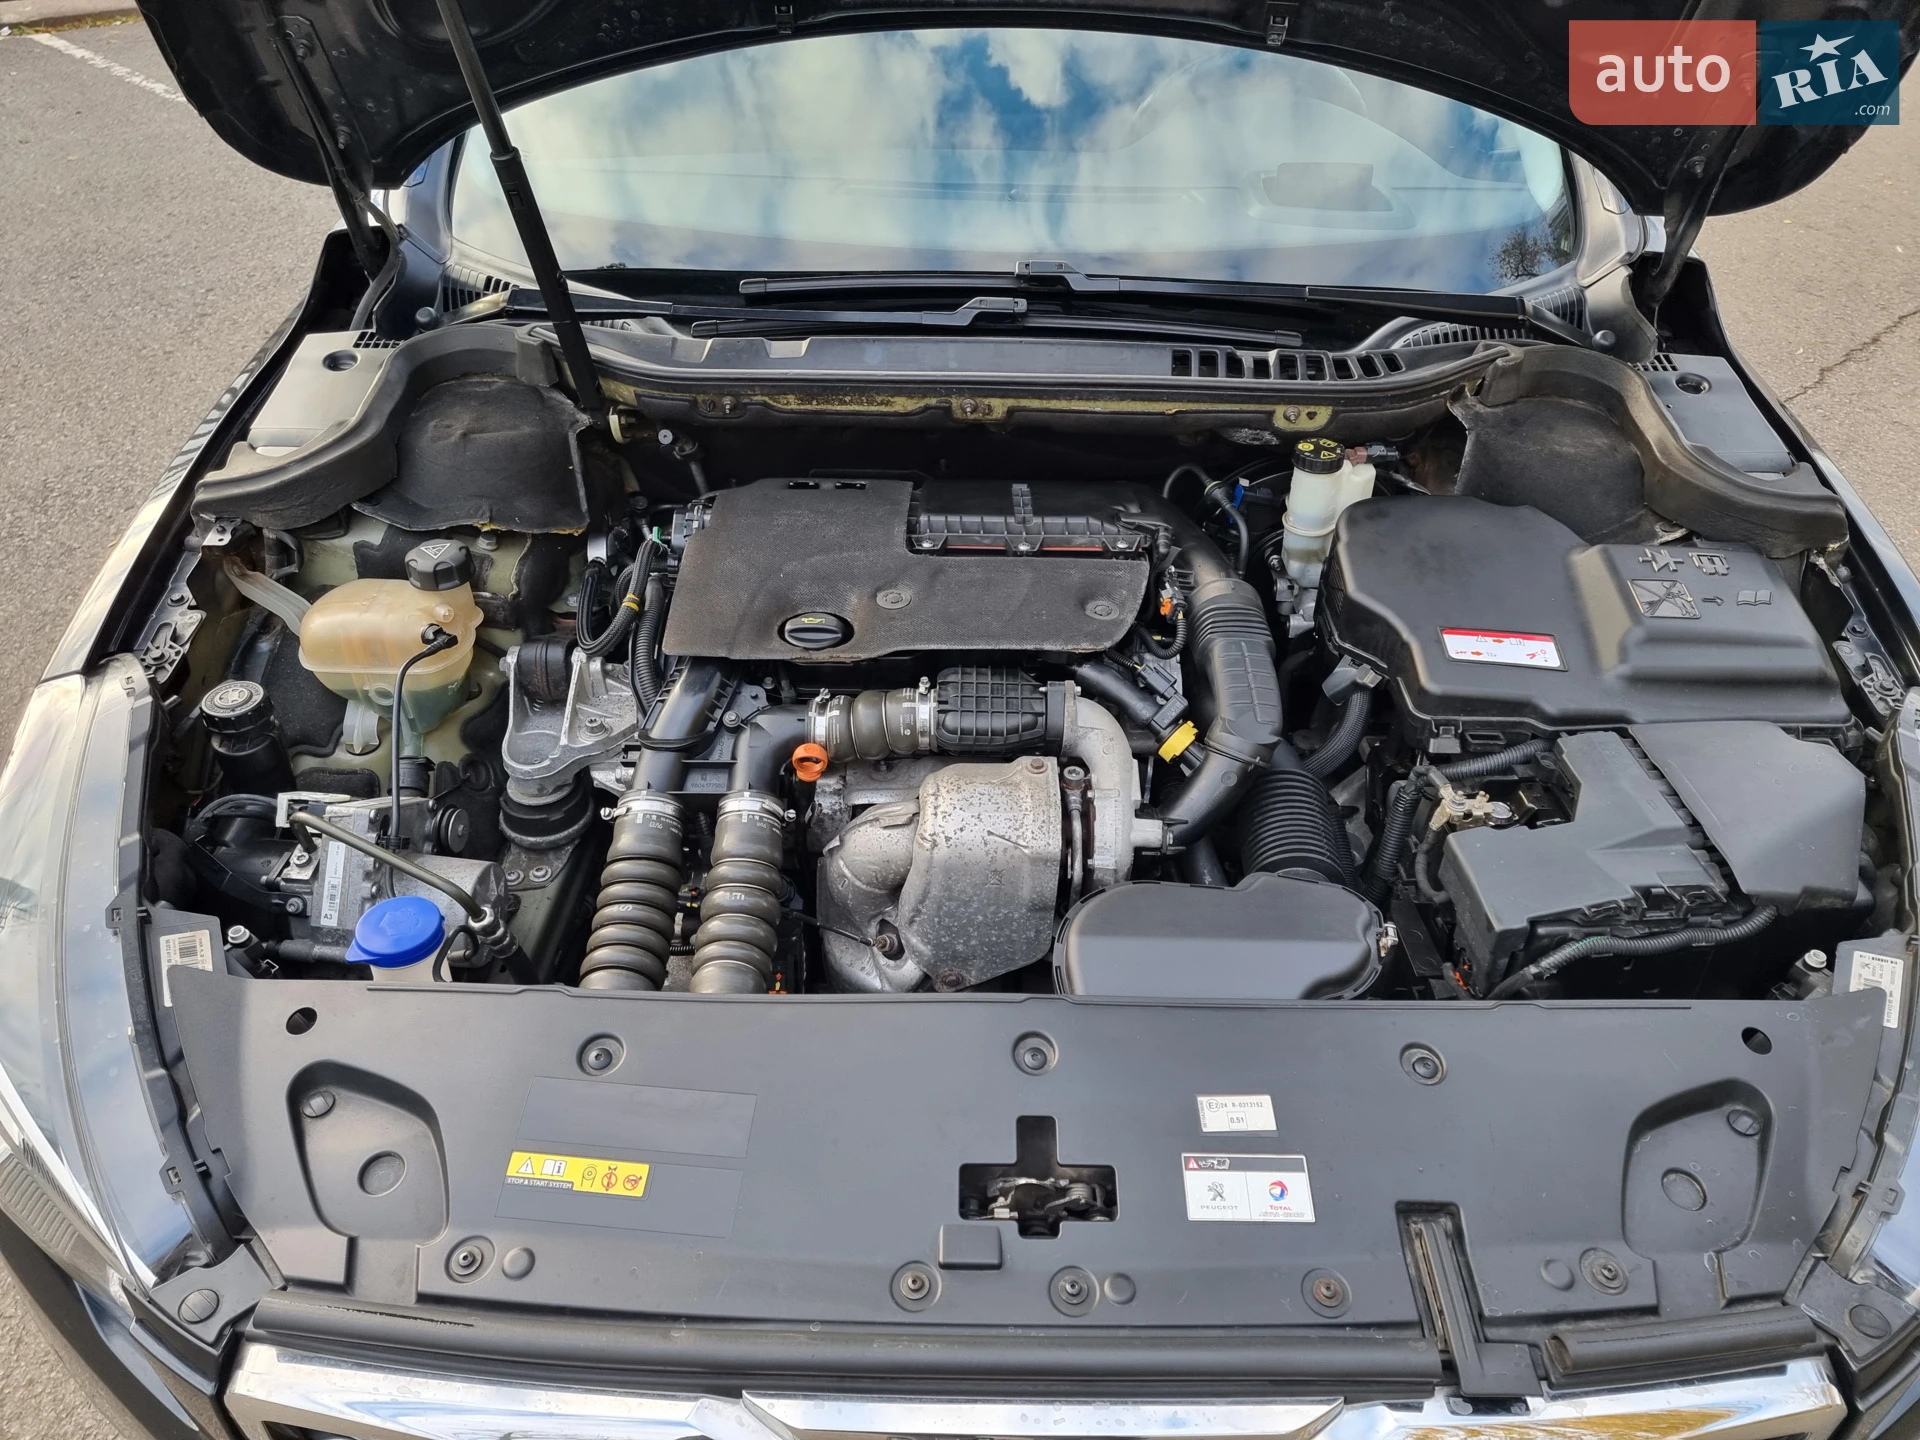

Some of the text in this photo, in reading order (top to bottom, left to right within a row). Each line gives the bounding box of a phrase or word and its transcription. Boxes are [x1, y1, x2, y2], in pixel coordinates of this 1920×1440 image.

[507, 1177, 524, 1185] STOP
[529, 1179, 549, 1188] START
[548, 1181, 573, 1190] SYSTEM
